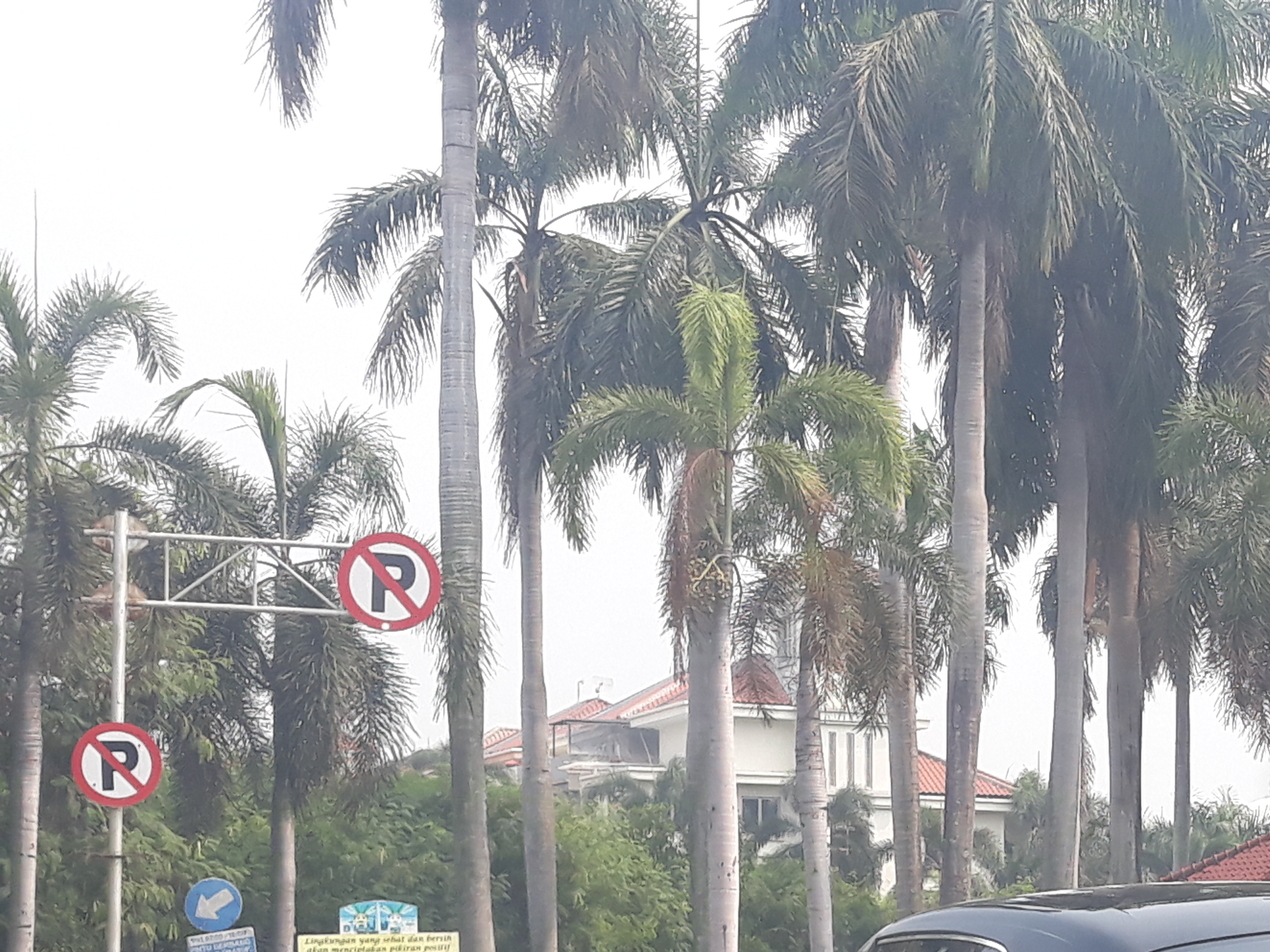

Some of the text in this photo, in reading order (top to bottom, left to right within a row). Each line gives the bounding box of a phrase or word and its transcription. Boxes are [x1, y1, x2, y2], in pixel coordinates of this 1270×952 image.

[304, 933, 452, 947] Lingkungan yang sehat dan bersih
[422, 943, 451, 952] positif
